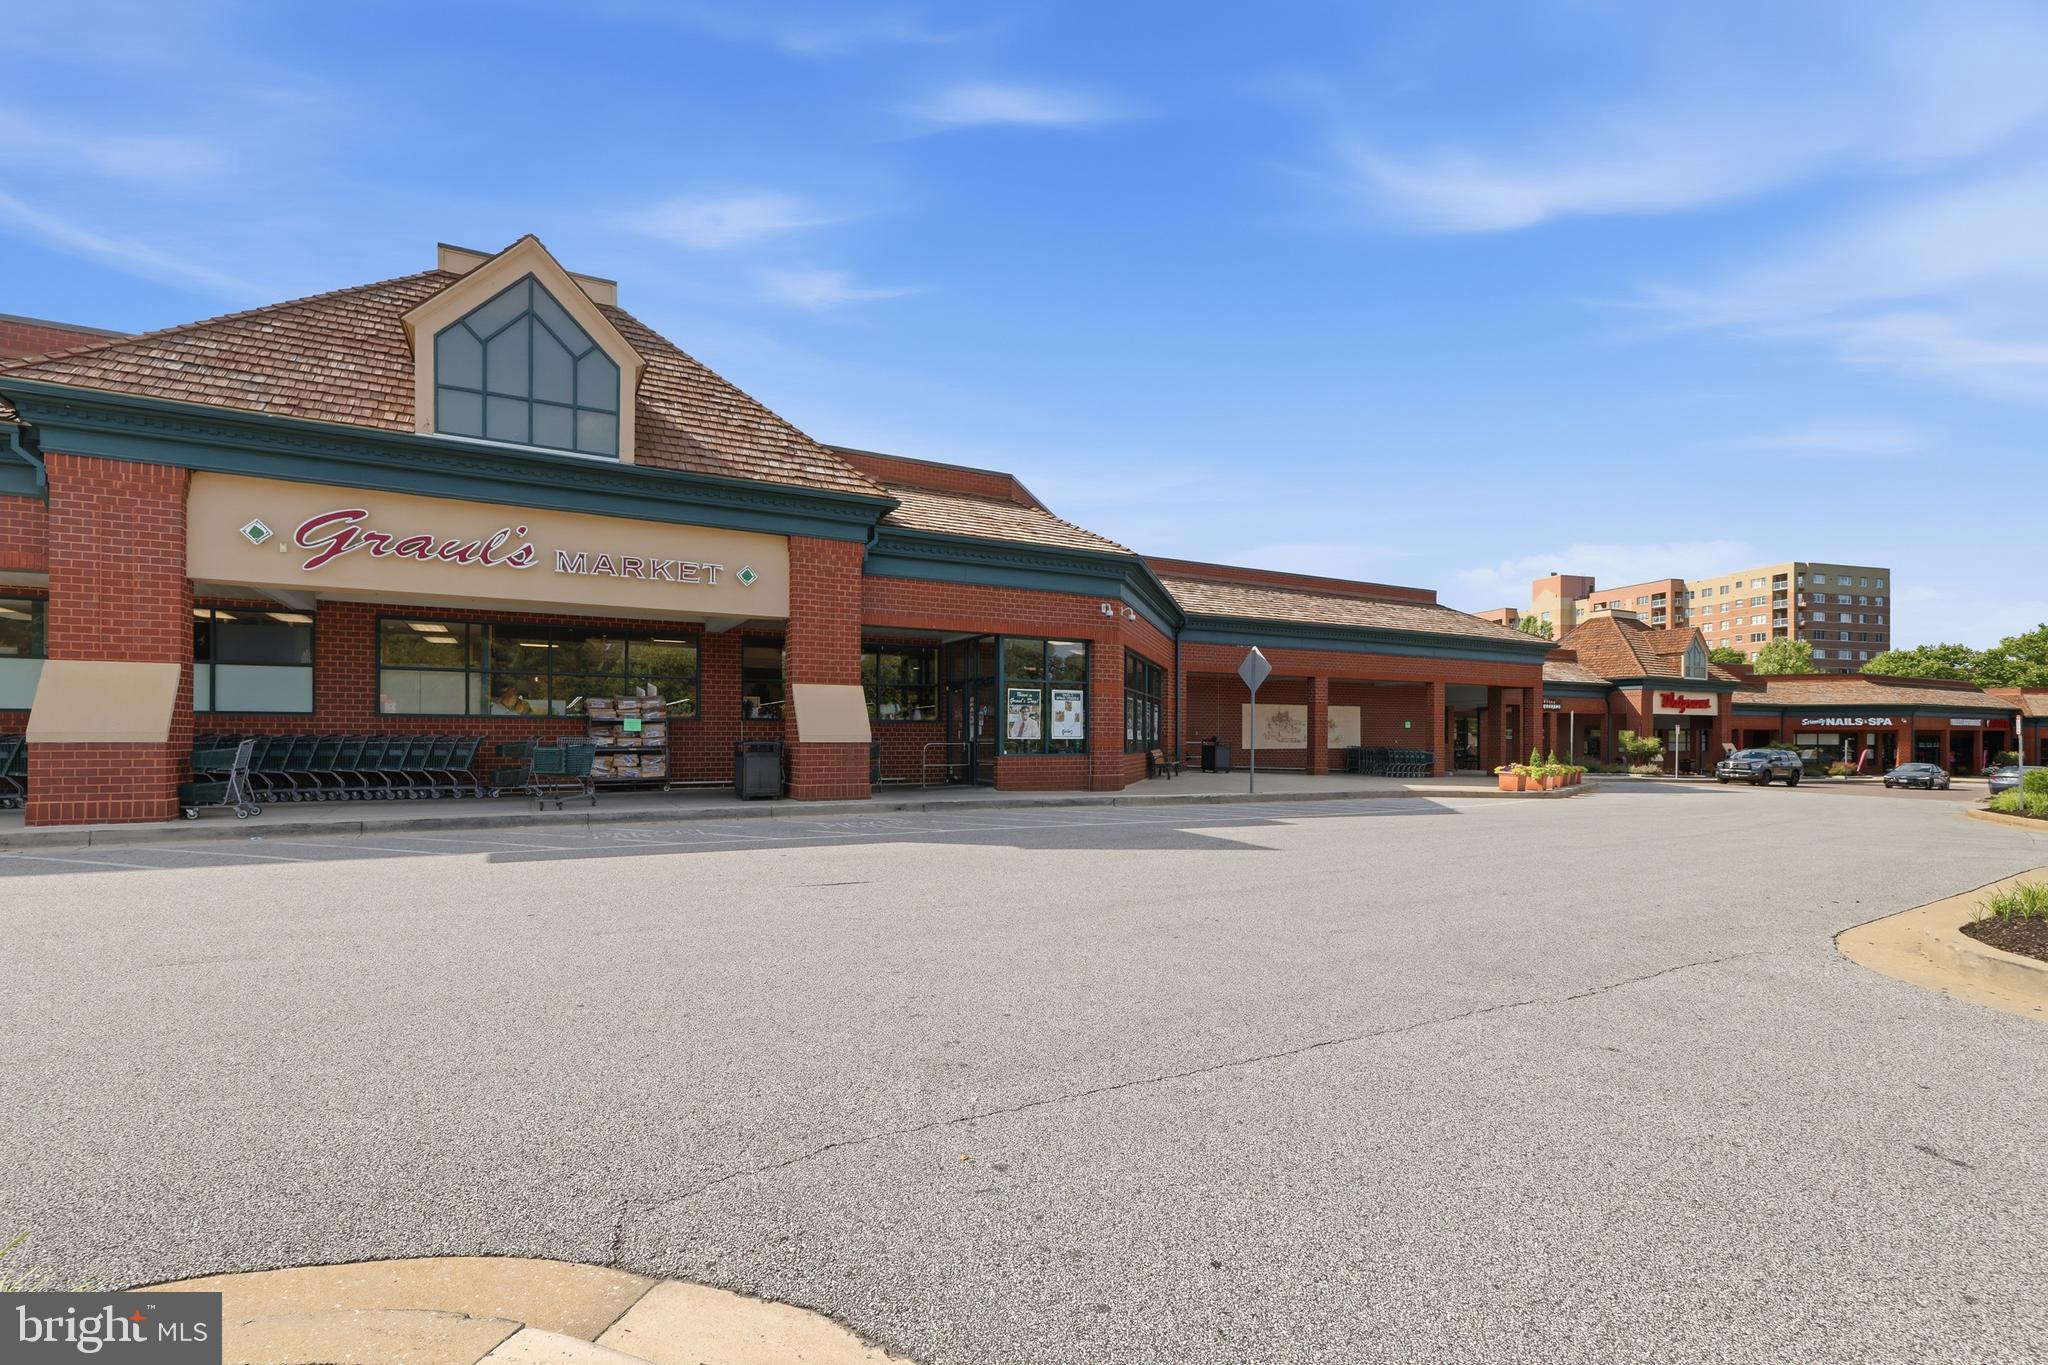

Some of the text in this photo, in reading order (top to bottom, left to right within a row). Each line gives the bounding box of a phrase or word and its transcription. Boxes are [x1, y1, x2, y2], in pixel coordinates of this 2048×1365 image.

[294, 508, 724, 585] Graul's MARKET
[1660, 691, 1711, 713] Walgreens
[1825, 717, 1863, 726] NAILS
[1868, 717, 1892, 726] SPA
